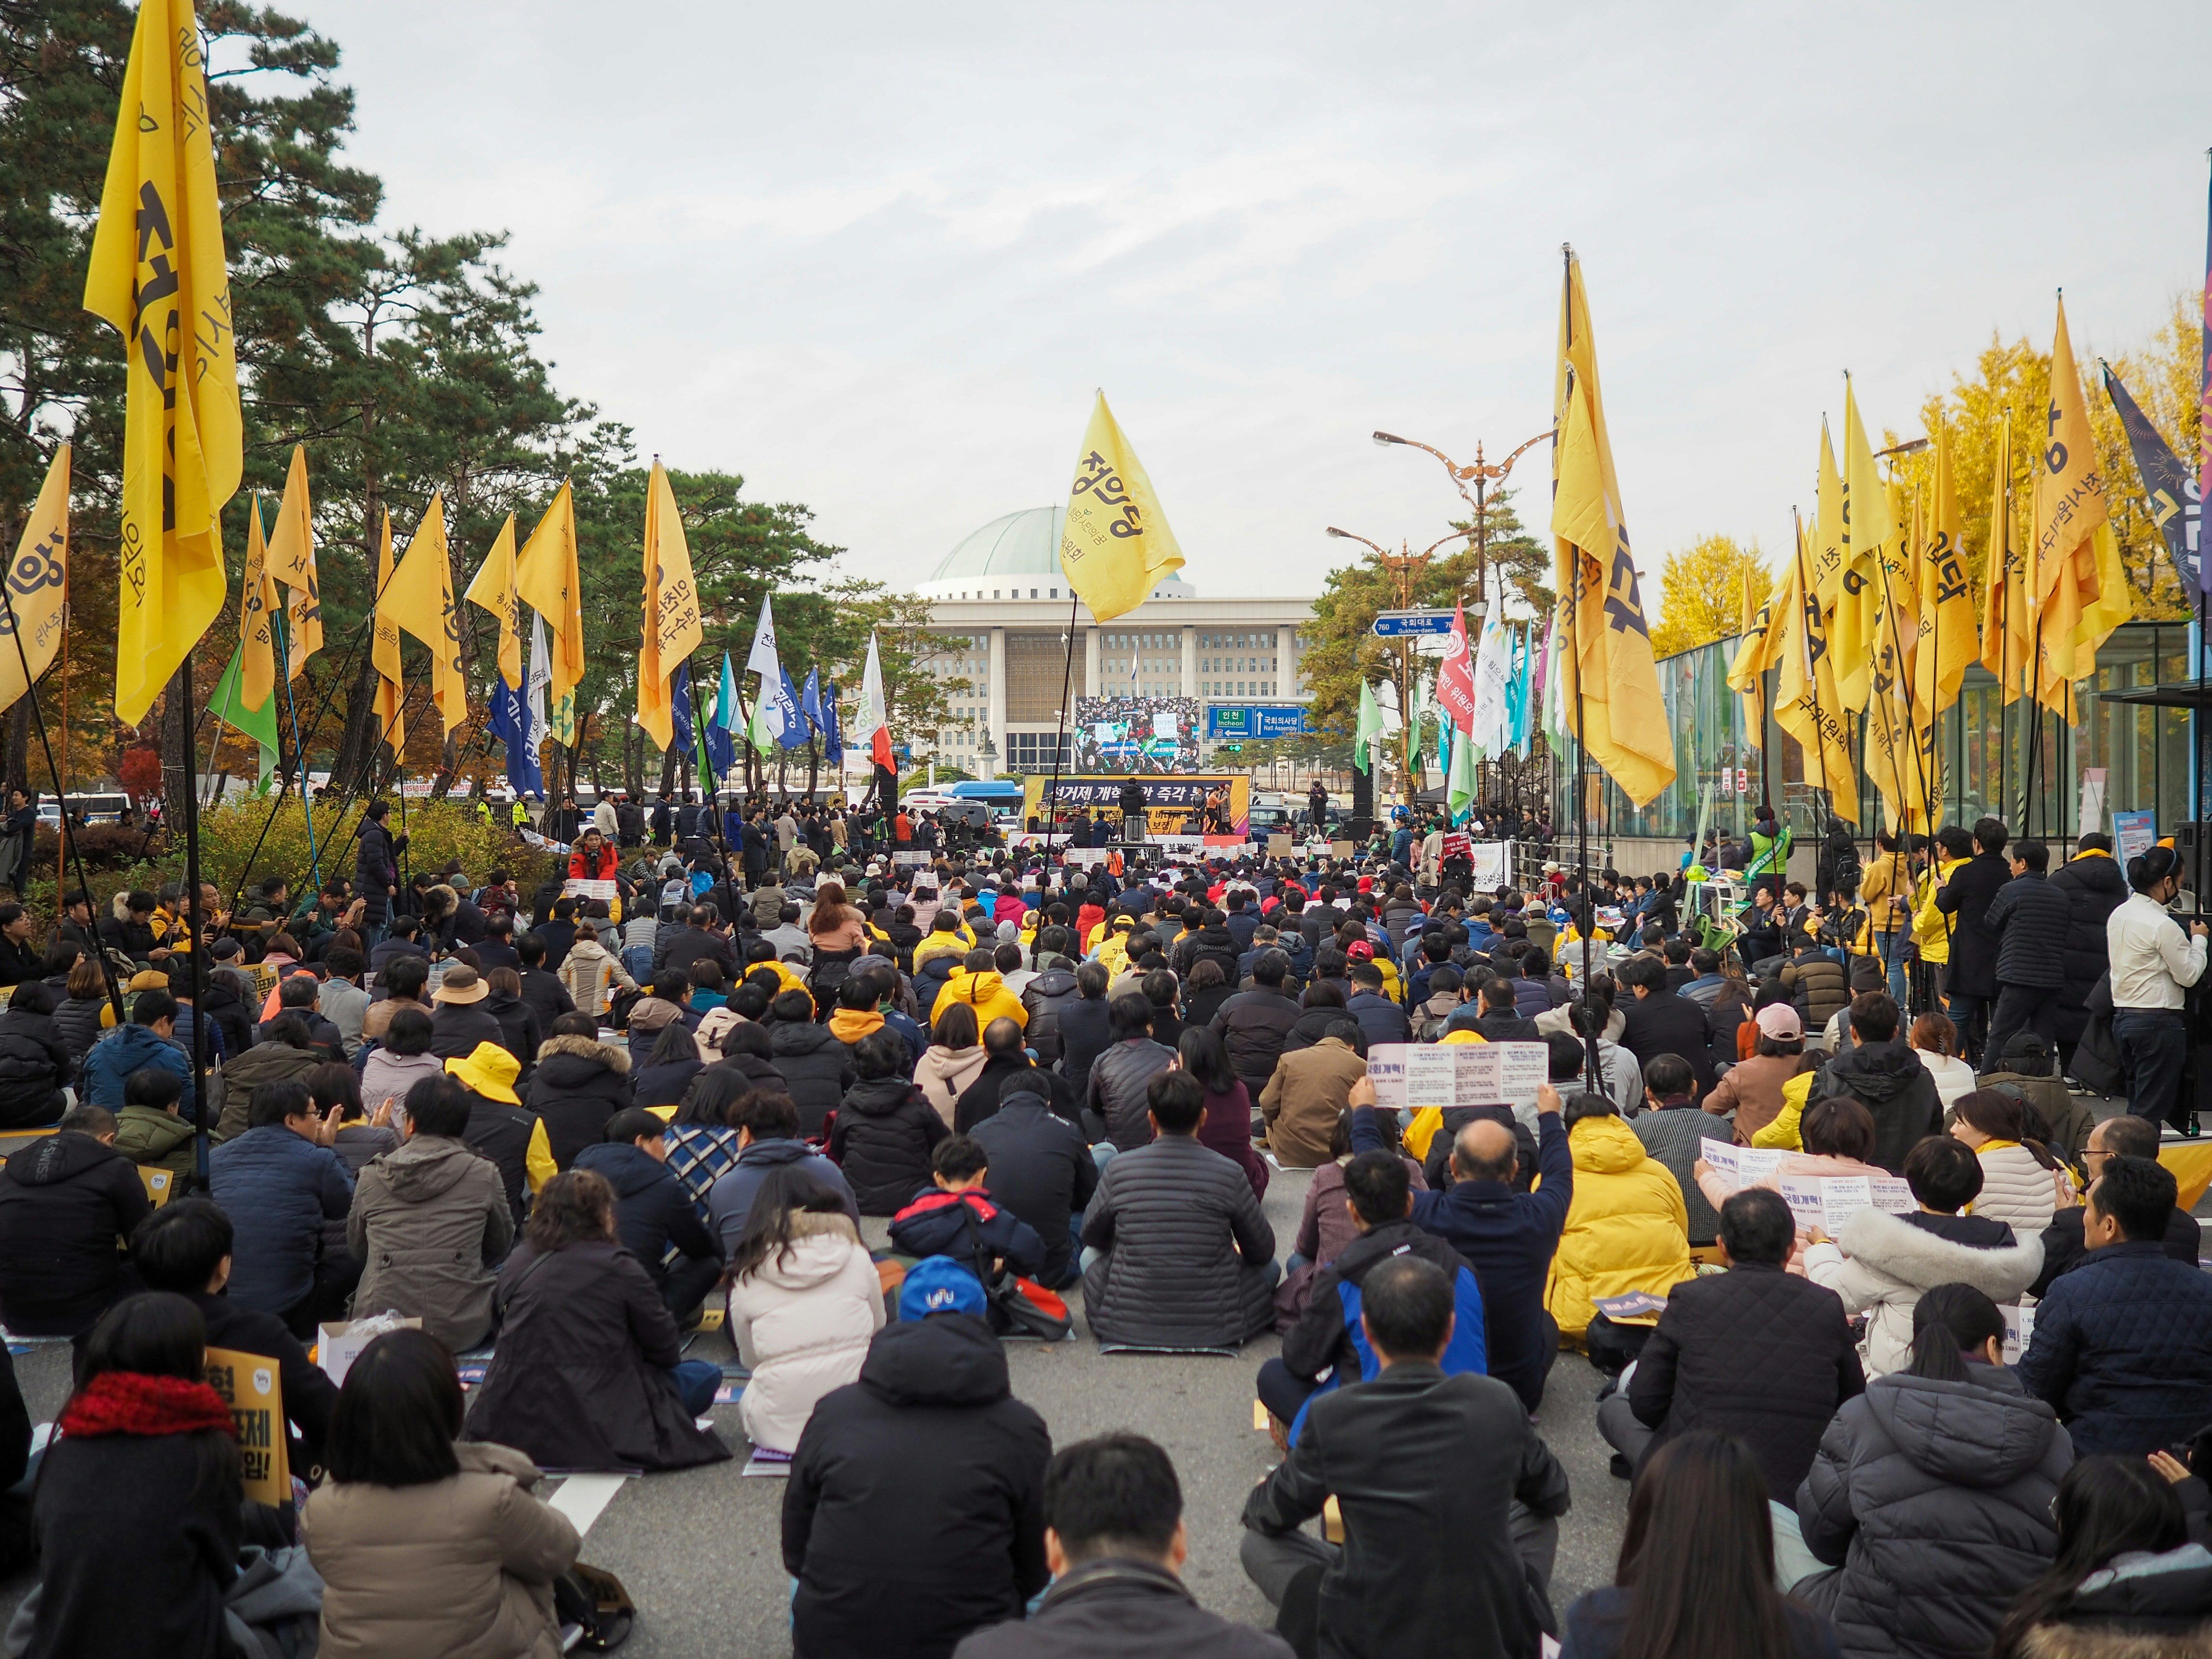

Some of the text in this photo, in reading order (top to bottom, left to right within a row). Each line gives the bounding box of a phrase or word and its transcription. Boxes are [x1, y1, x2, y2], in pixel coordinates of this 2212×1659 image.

[1072, 450, 1143, 538] 정의당
[1078, 517, 1099, 541] 시민의
[1093, 532, 1108, 546] 꿈
[1451, 686, 1475, 715] 위원회
[1264, 717, 1297, 725] 국회의사당
[1050, 786, 1093, 801] 선거제
[1157, 787, 1187, 802] 즉각
[1197, 944, 1232, 952] Reebok
[1705, 1152, 1738, 1169] 국회개혁!
[1784, 1193, 1822, 1206] 국회개혁!
[243, 1450, 271, 1481] 입!
